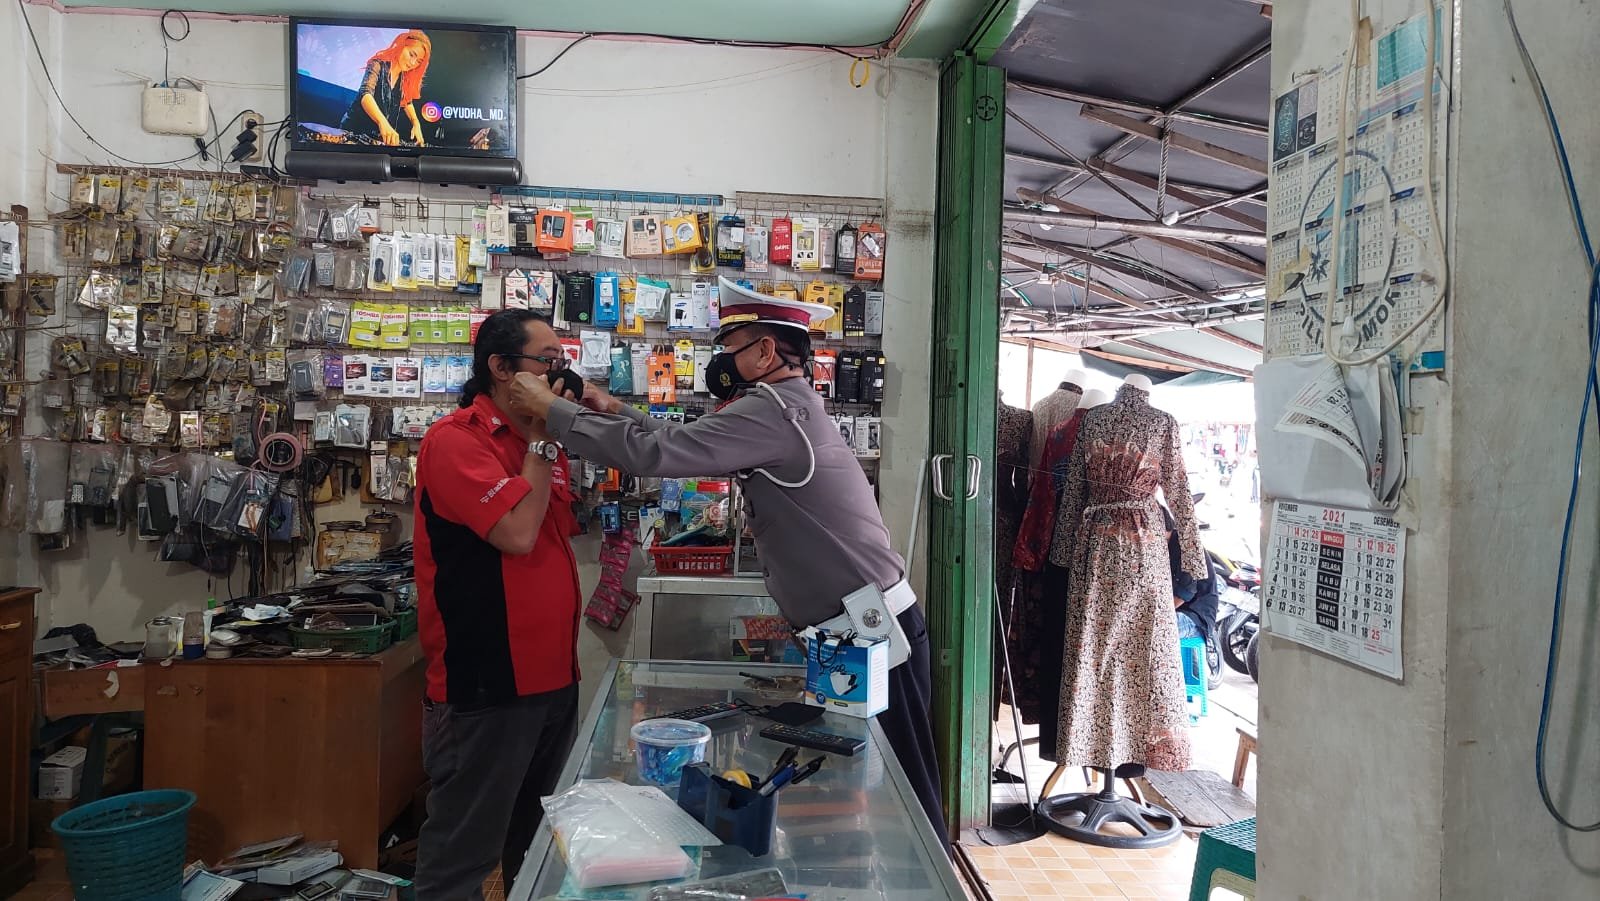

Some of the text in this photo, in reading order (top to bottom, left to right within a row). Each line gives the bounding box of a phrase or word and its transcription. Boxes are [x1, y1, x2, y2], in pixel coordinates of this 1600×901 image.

[1322, 509, 1345, 523] 2021
[1301, 542, 1308, 551] 22
[1310, 543, 1319, 552] 29
[1322, 548, 1342, 558] SENIN
[1366, 554, 1372, 565] 13
[1376, 557, 1384, 567] 20
[1386, 559, 1394, 569] 27
[1367, 540, 1373, 550] 12
[1300, 555, 1307, 565] 23
[1321, 562, 1341, 572] SELASA
[1366, 569, 1372, 579] 14
[1375, 572, 1383, 582] 21
[1385, 574, 1394, 584] 28
[1319, 575, 1339, 586] RABU
[1365, 584, 1371, 594] 15
[1374, 586, 1382, 597] 22
[1385, 589, 1393, 599] 29
[1281, 589, 1287, 598] 12
[1383, 618, 1391, 629] 31
[1318, 588, 1337, 599] KAMIS
[1374, 601, 1381, 612] 23
[1384, 604, 1392, 614] 30
[1279, 601, 1286, 611] 13
[1289, 605, 1296, 614] 20
[1298, 606, 1305, 616] 27
[1372, 629, 1380, 640] 25
